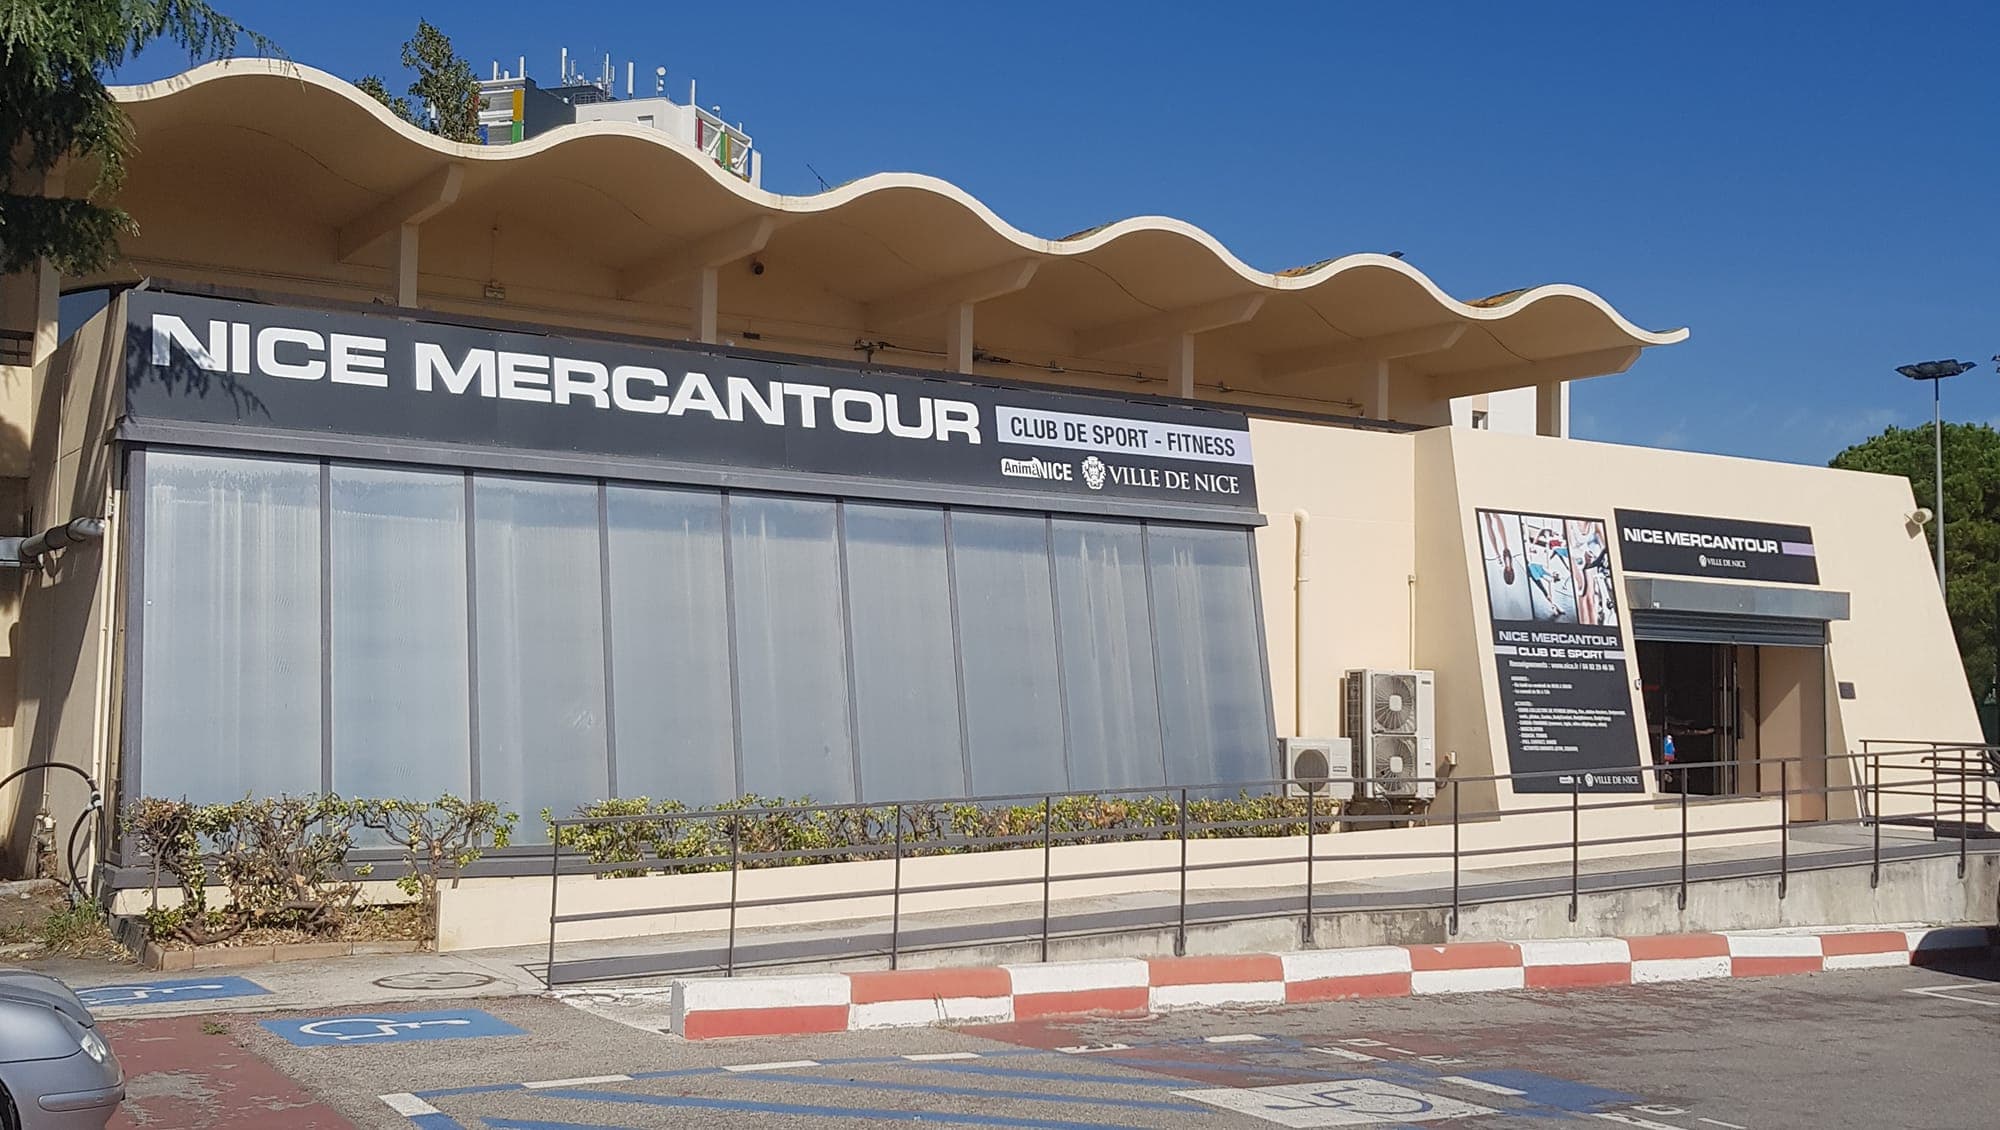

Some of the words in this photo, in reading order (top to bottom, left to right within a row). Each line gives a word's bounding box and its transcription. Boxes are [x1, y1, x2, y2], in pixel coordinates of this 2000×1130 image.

[151, 314, 388, 388] NICE
[414, 342, 981, 444] MERCANTOUR
[1010, 416, 1058, 440] CLUB
[1064, 422, 1088, 443] DE
[1093, 424, 1149, 449] SPORT
[1167, 432, 1235, 457] FITNESS
[1107, 465, 1161, 488] VILLE
[1165, 471, 1192, 490] DE
[1195, 474, 1240, 494] NICE
[1623, 527, 1664, 544] NICE
[1665, 532, 1778, 554] MERCANTOUR
[1498, 630, 1529, 642] NICE
[1531, 632, 1618, 647] MERCANTOUR
[1518, 646, 1549, 657] CLUB
[1550, 648, 1566, 658] DE
[1567, 649, 1604, 660] SPORT
